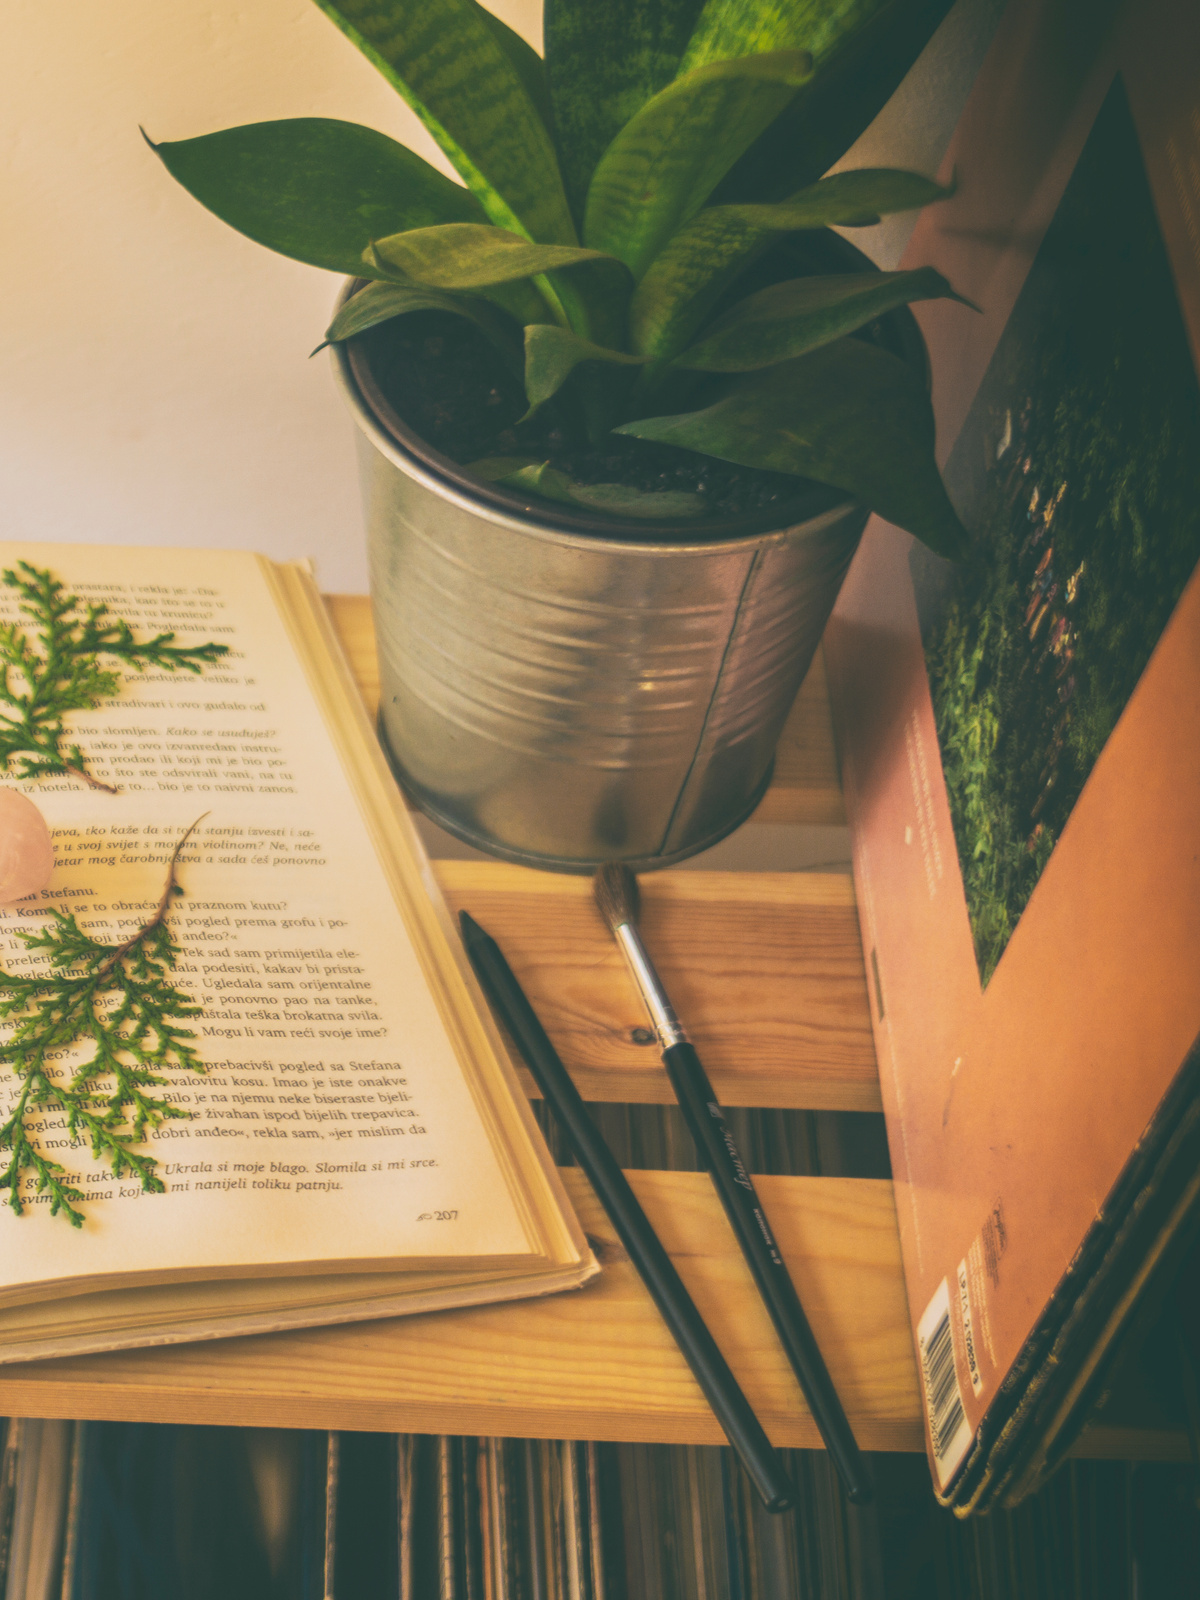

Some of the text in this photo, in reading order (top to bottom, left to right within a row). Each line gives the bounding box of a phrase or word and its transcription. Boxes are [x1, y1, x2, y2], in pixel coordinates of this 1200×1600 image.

[77, 726, 98, 734] bio
[103, 726, 160, 737] slomljen.
[166, 728, 197, 736] Kako
[218, 729, 276, 740] usuđuješ?
[86, 826, 285, 837] tko kaže da si stanju izvesti
[41, 887, 98, 899] Stefanu.
[188, 903, 247, 911] praznom
[250, 901, 287, 910] kutu?
[180, 948, 204, 957] Tek
[208, 948, 230, 957] sad
[264, 949, 333, 960] primijetila
[336, 949, 359, 958] ele-
[202, 1026, 242, 1038] Mogu
[244, 1027, 254, 1036] li
[290, 1028, 315, 1037] reći
[318, 1028, 352, 1040] svoje
[356, 1028, 387, 1037] ime?
[206, 1060, 273, 1073] prebacivši
[278, 1061, 325, 1073] pogled
[349, 1060, 402, 1071] Stefana
[163, 1093, 190, 1103] Bilo
[194, 1092, 206, 1104] je
[232, 1093, 274, 1105] njemu
[278, 1094, 310, 1103] neke
[314, 1094, 374, 1104] biseraste
[377, 1092, 412, 1104] bjeli-
[205, 1108, 419, 1122] živahan ispod bijelih trepavica.
[152, 1124, 426, 1140] dobri anđeo«, rekla sam, »jer mislim da
[165, 1162, 212, 1174] Ukrala
[217, 1162, 228, 1171] si
[234, 1162, 264, 1174] moje
[270, 1162, 308, 1175] blago.
[315, 1162, 366, 1173] Slomila
[388, 1159, 404, 1170] mi
[410, 1160, 438, 1168] srce.
[172, 1178, 342, 1192] mi nanijeli toliku patnju.
[434, 1210, 458, 1220] 207
